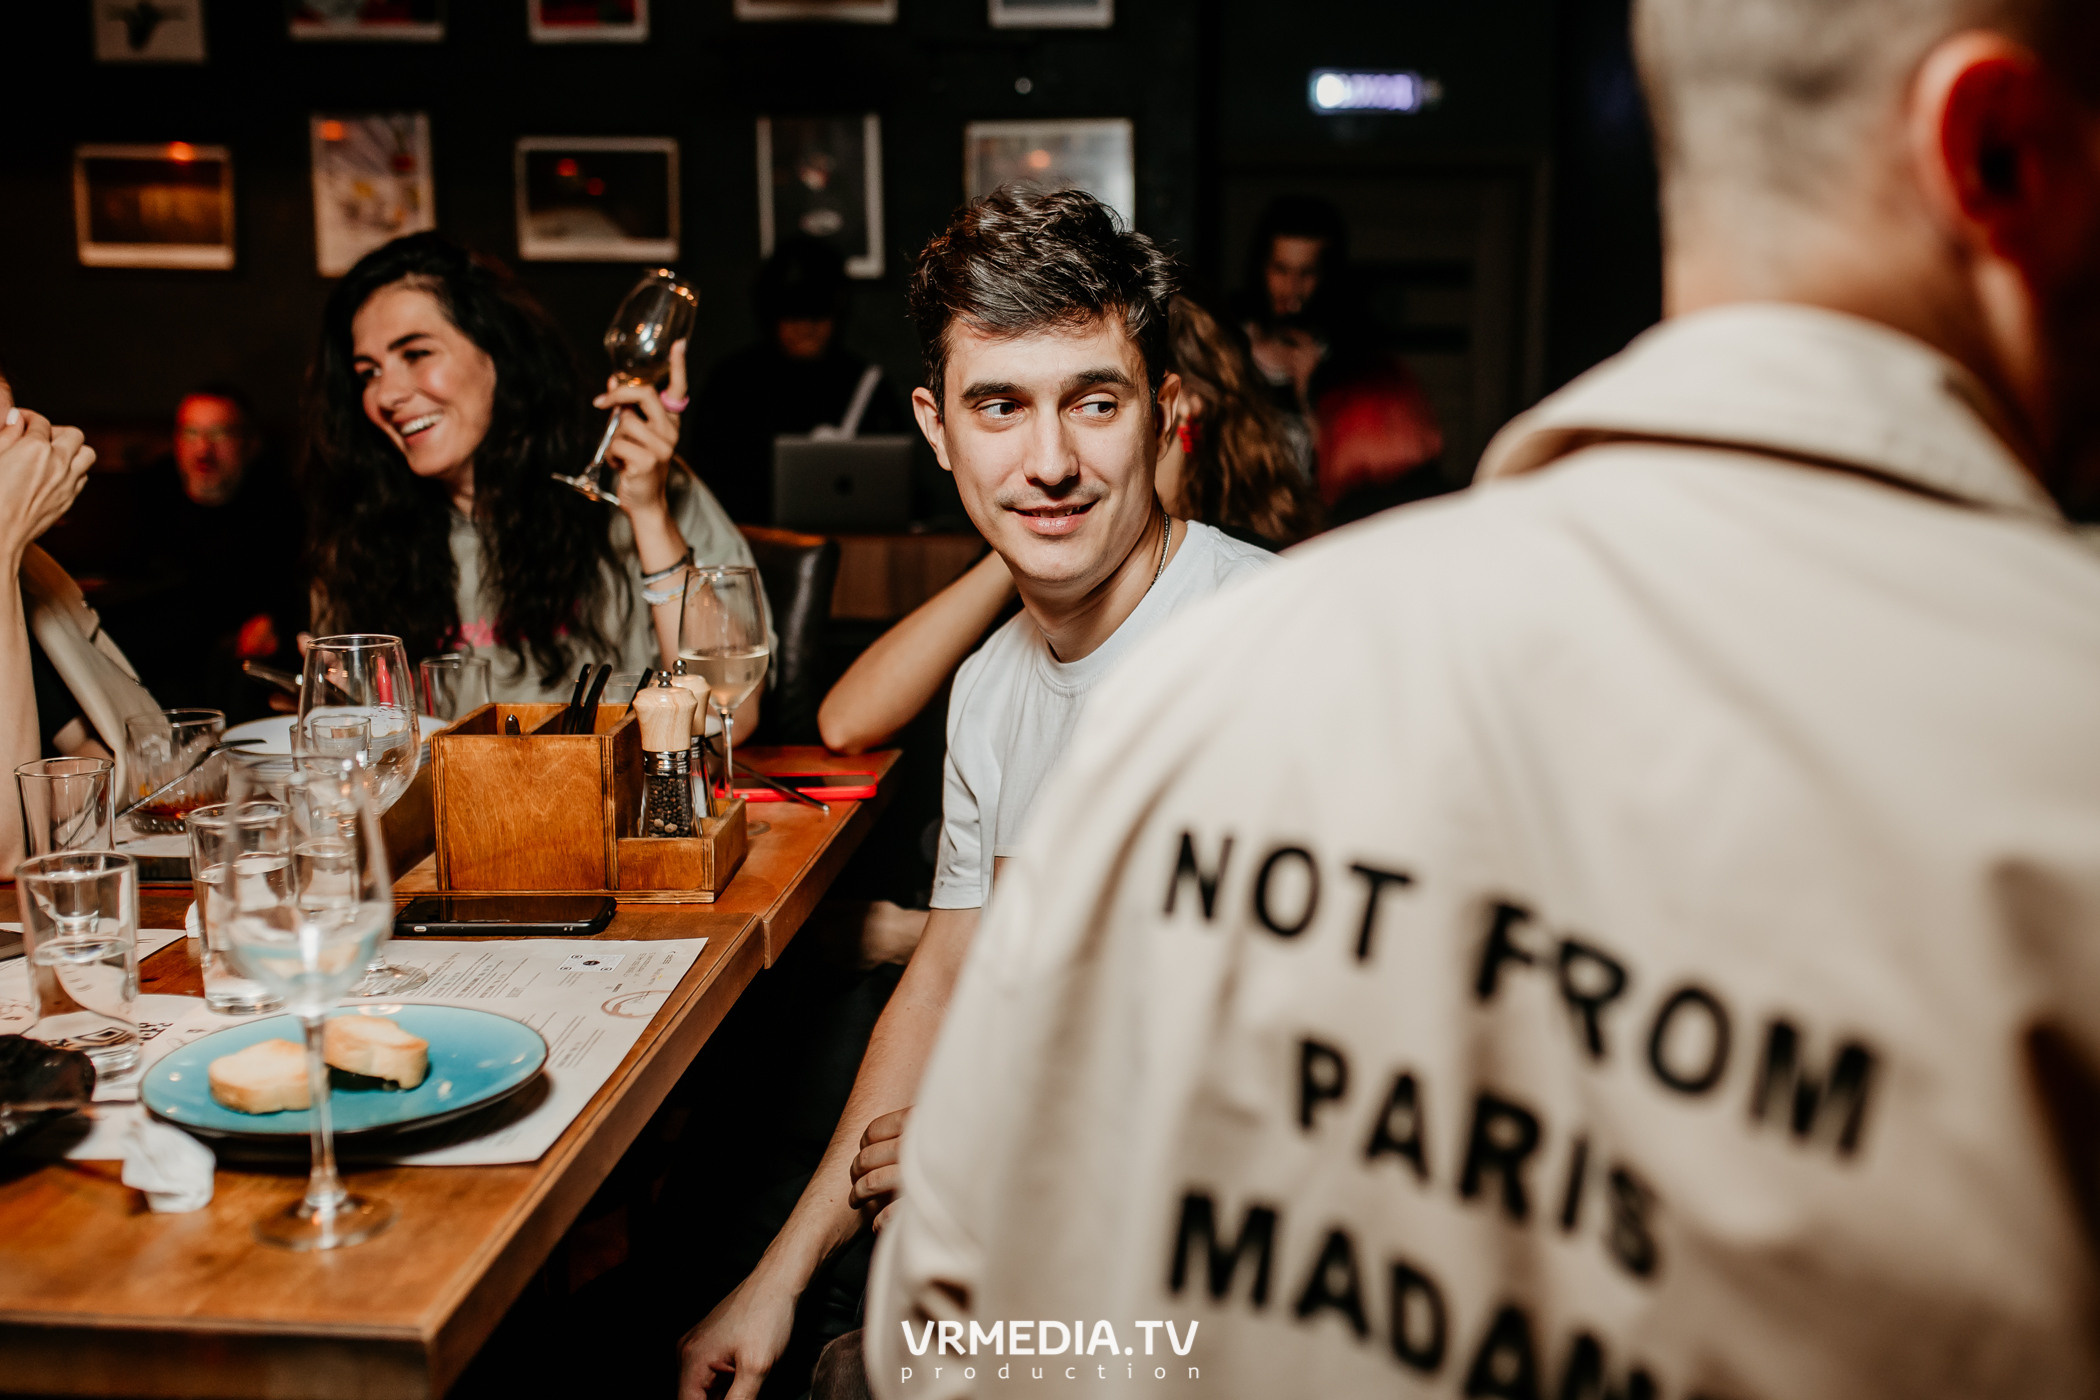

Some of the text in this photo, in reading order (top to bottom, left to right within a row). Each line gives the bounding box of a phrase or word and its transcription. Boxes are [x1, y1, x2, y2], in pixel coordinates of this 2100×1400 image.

[1164, 828, 1882, 1164] NOT FROM
[1293, 1036, 1662, 1281] PARIS
[1167, 1190, 1704, 1400] MADAM
